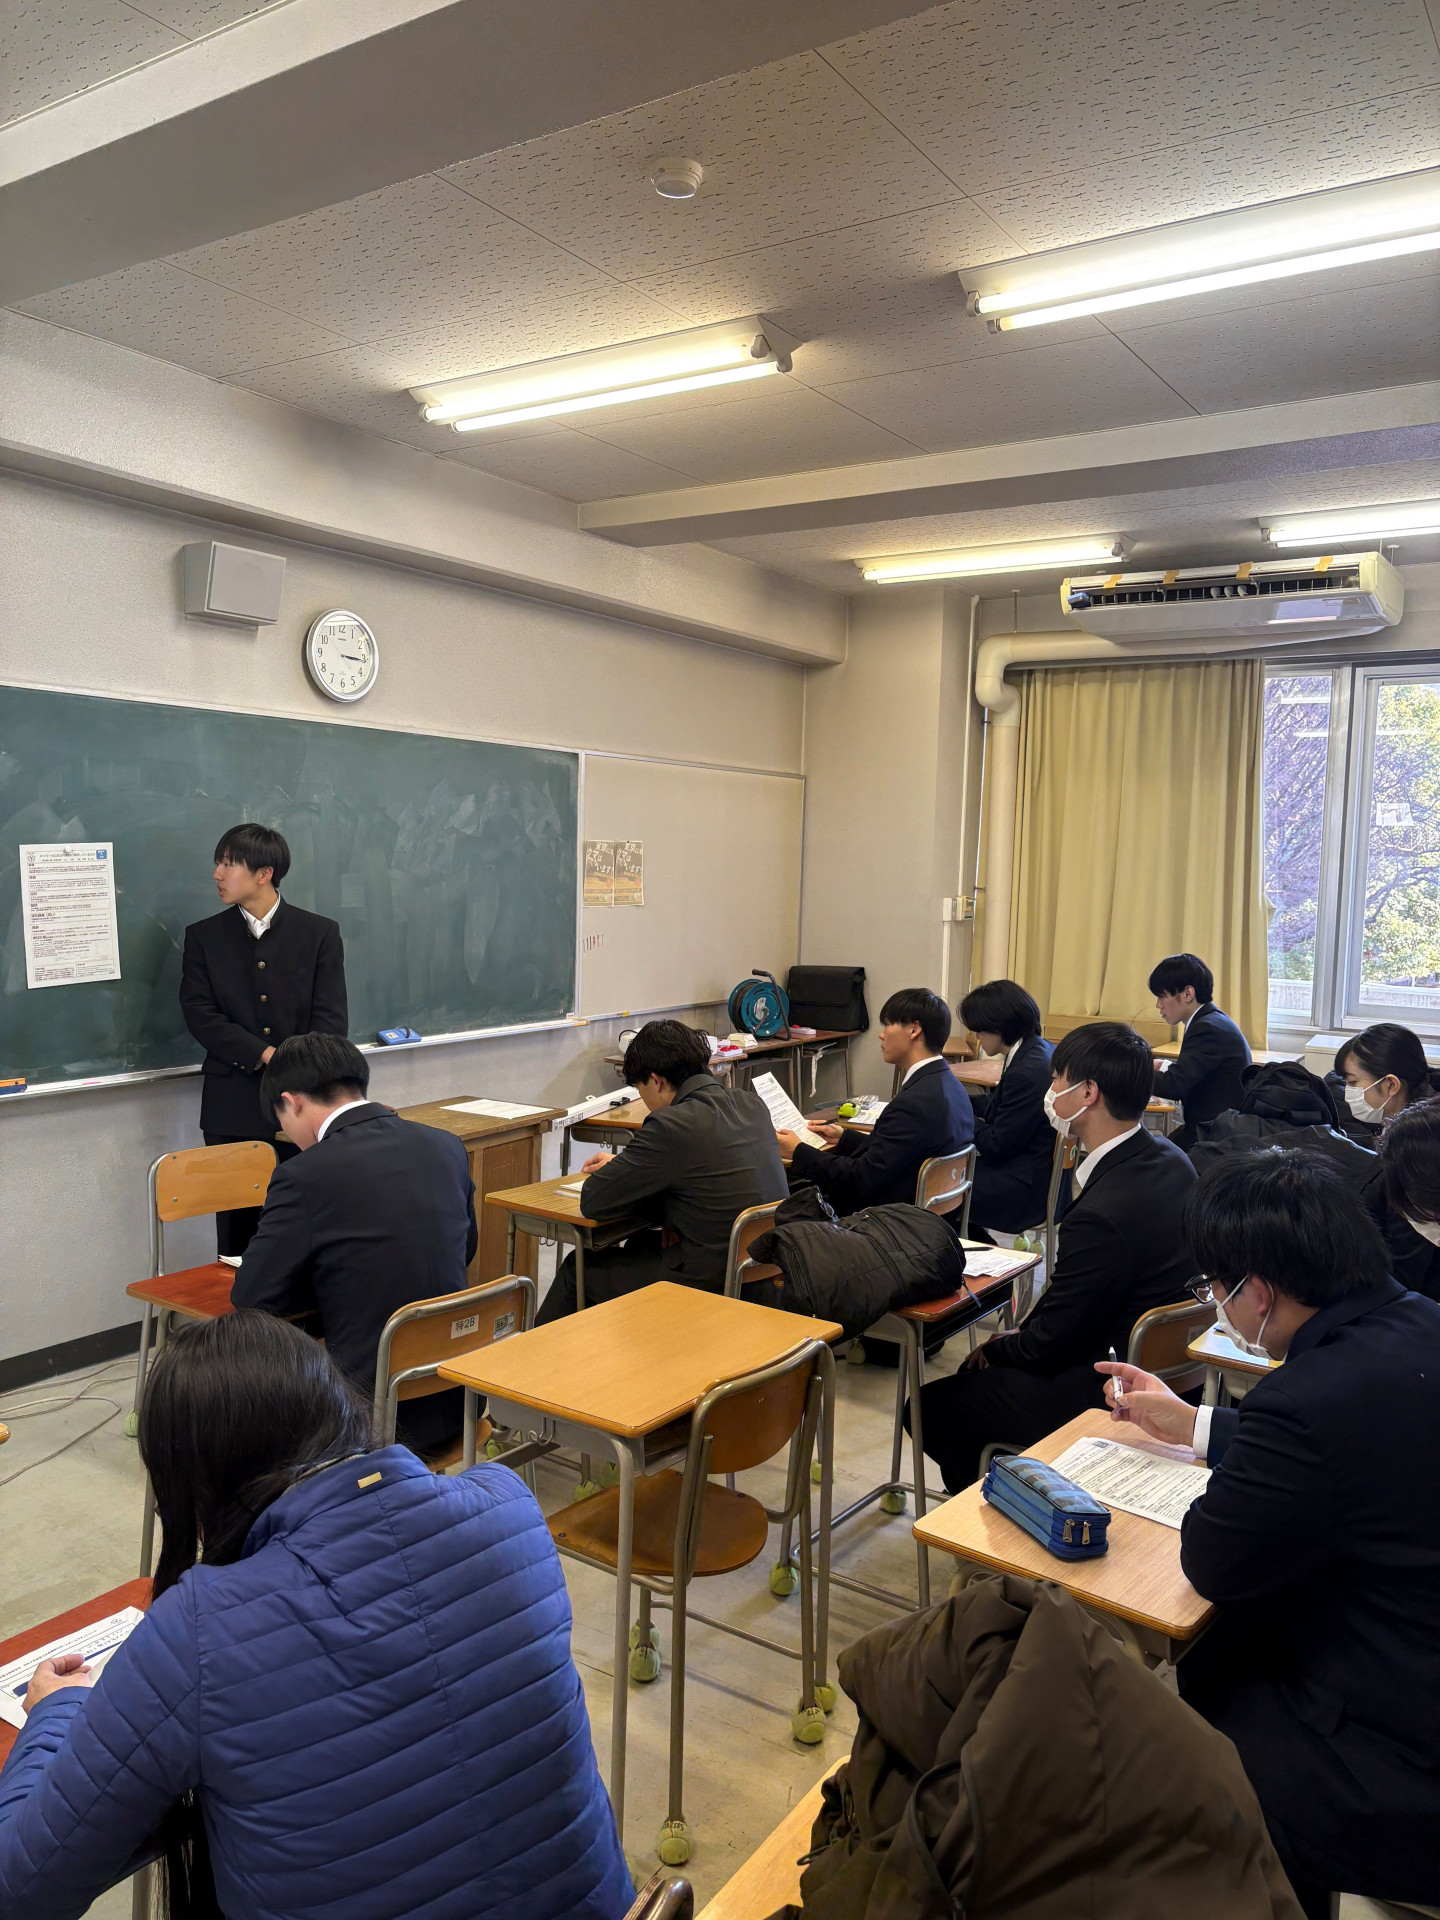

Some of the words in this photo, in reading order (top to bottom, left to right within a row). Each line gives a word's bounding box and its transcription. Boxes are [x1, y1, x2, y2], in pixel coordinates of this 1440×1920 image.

[329, 626, 335, 636] 11
[338, 625, 345, 633] 12
[321, 635, 328, 644] 10
[358, 640, 362, 649] 2
[318, 648, 322, 657] 9
[362, 654, 366, 663] 3
[321, 663, 326, 672] 8
[358, 667, 362, 677] 4
[329, 673, 334, 684] 7
[340, 678, 345, 688] 6
[351, 676, 355, 685] 5
